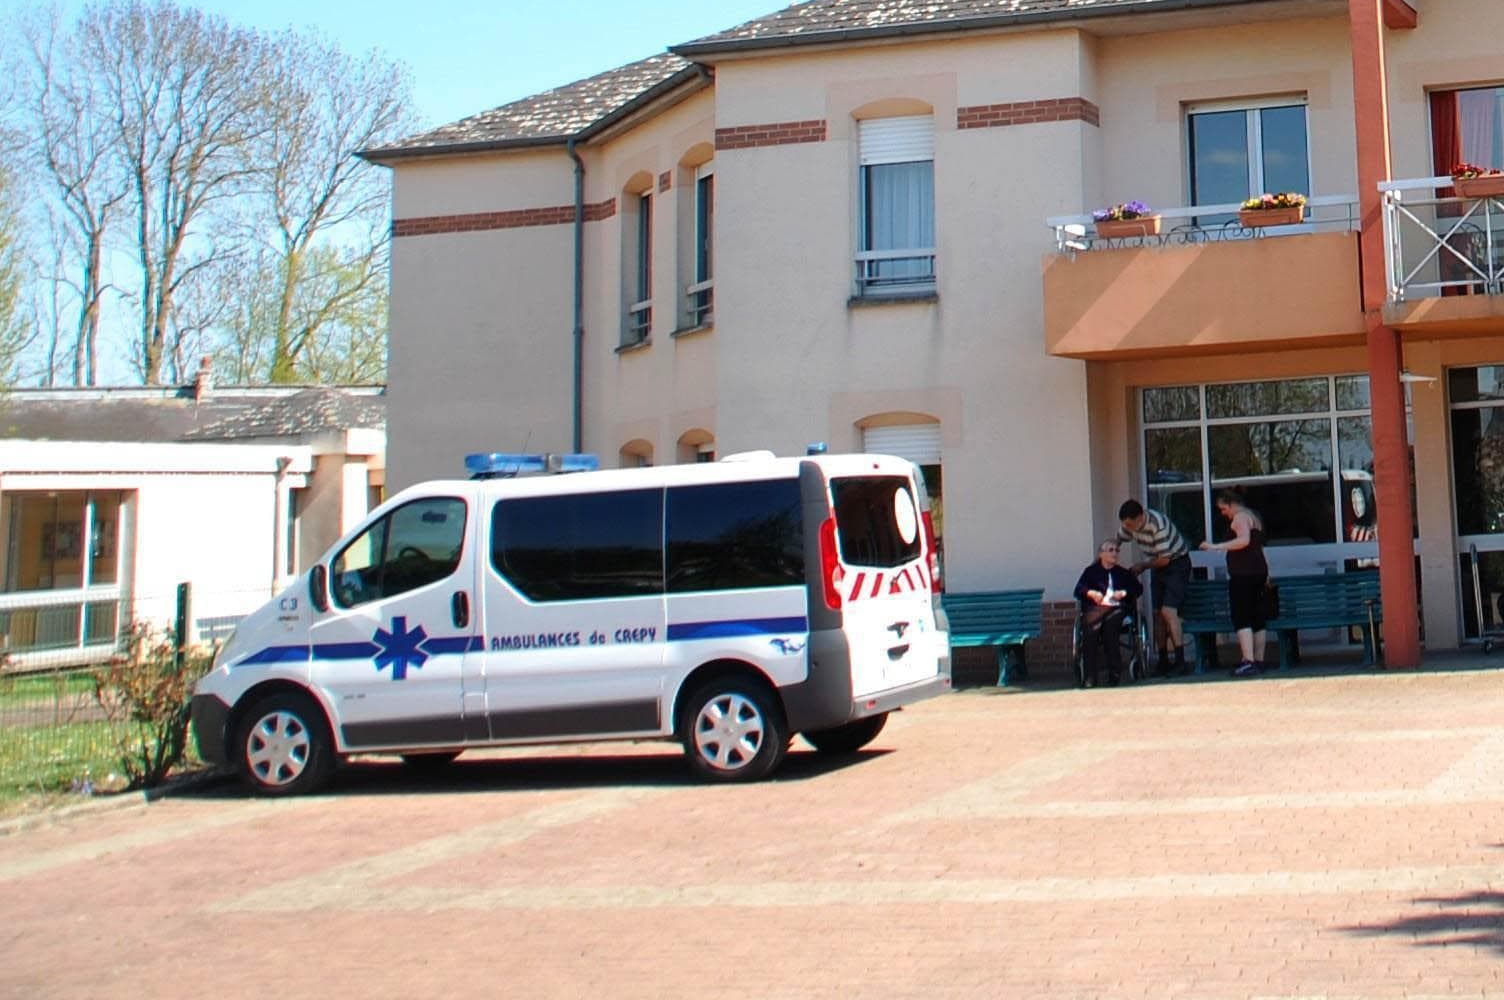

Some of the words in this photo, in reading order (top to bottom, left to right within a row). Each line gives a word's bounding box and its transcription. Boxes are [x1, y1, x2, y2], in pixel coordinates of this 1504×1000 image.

[491, 631, 581, 650] AMBULANCES
[589, 629, 606, 645] de
[614, 627, 657, 644] CREPY
